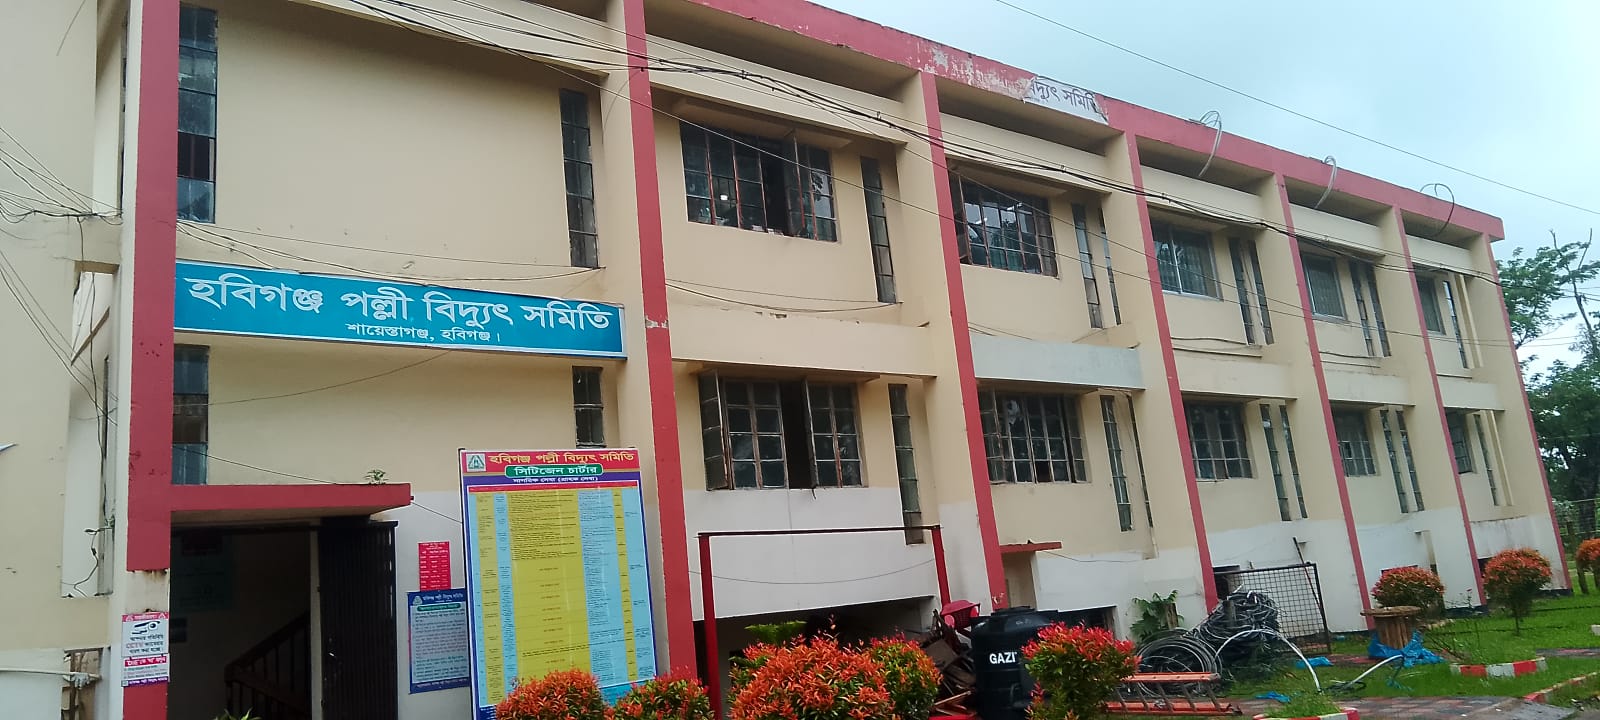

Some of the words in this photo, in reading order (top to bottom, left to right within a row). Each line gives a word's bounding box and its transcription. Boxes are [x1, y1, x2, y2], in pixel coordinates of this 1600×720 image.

[183, 272, 324, 314] হবিগঞ্জ
[340, 286, 415, 321] পল্লী
[421, 290, 514, 330] বিদ্যুৎ
[519, 300, 614, 331] সমিতি
[488, 452, 531, 464] হবিগঞ্জ
[535, 451, 559, 464] পল্লী
[563, 451, 598, 464] বিদ্যুৎ
[599, 451, 634, 462] সমিতি
[513, 465, 564, 476] সিটিজেন
[567, 464, 598, 475] চার্টার
[989, 651, 1016, 665] GAZI
